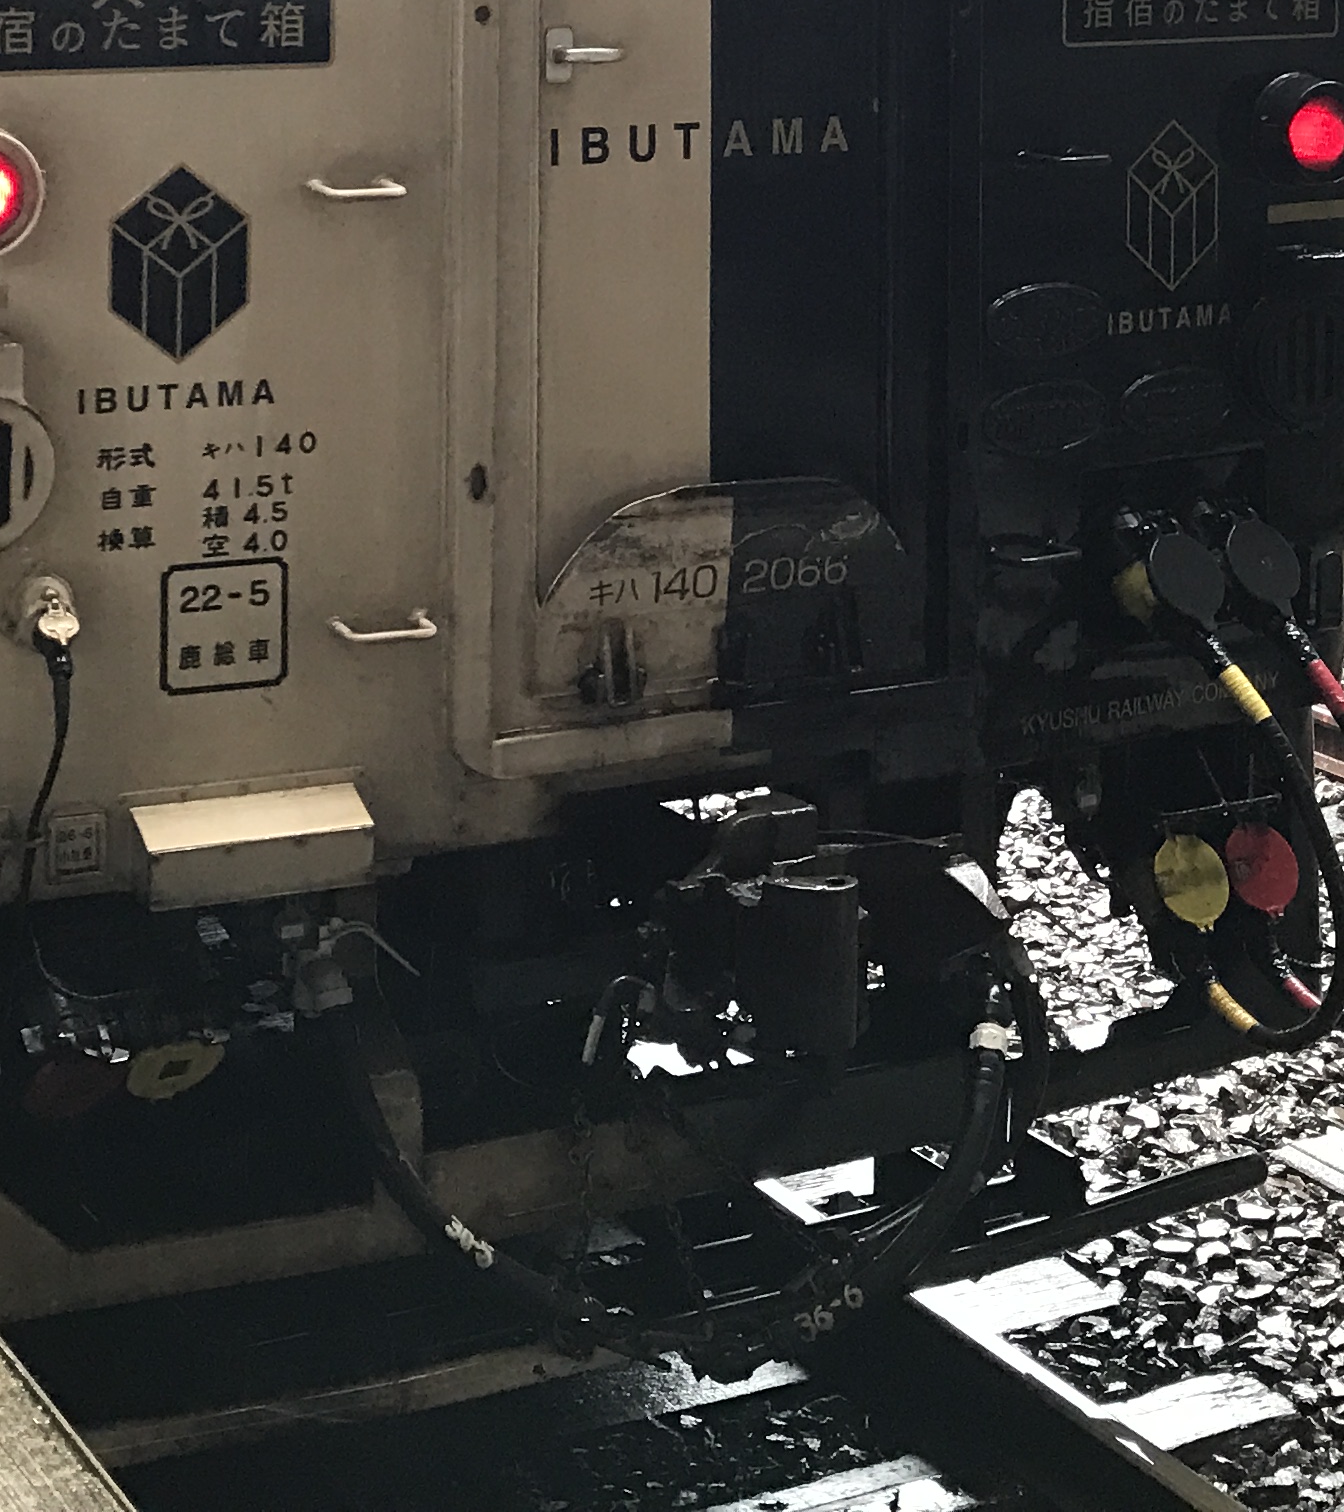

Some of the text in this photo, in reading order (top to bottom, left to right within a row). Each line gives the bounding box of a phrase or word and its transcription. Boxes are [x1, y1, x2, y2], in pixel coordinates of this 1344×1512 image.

[549, 115, 849, 167] IBUTAMA
[1107, 304, 1234, 336] IBUTAMA
[77, 378, 276, 415] IBUTAMA
[96, 442, 156, 471] 形式
[101, 484, 157, 510] 自重
[742, 554, 849, 595] 2066
[179, 578, 271, 614] 22-5
[1021, 705, 1101, 736] KYUSHU
[1108, 690, 1185, 720] RAILWAY
